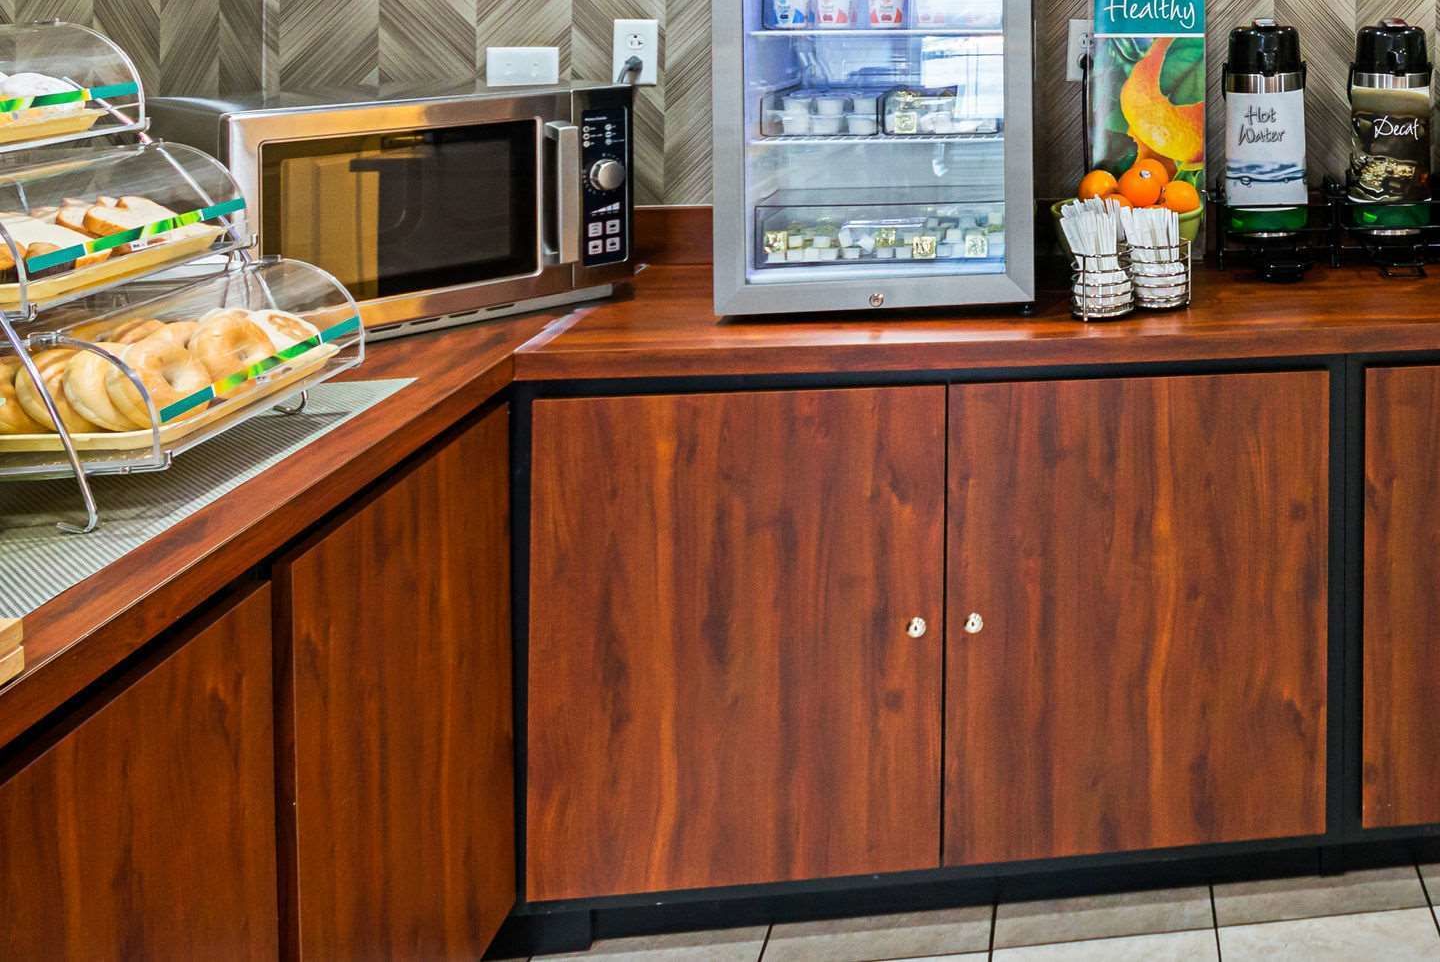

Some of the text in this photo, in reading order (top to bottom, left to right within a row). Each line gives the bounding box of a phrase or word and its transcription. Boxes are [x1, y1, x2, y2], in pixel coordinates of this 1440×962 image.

[1244, 104, 1277, 125] Hot
[1238, 123, 1286, 146] Water
[1373, 115, 1420, 140] Decaf
